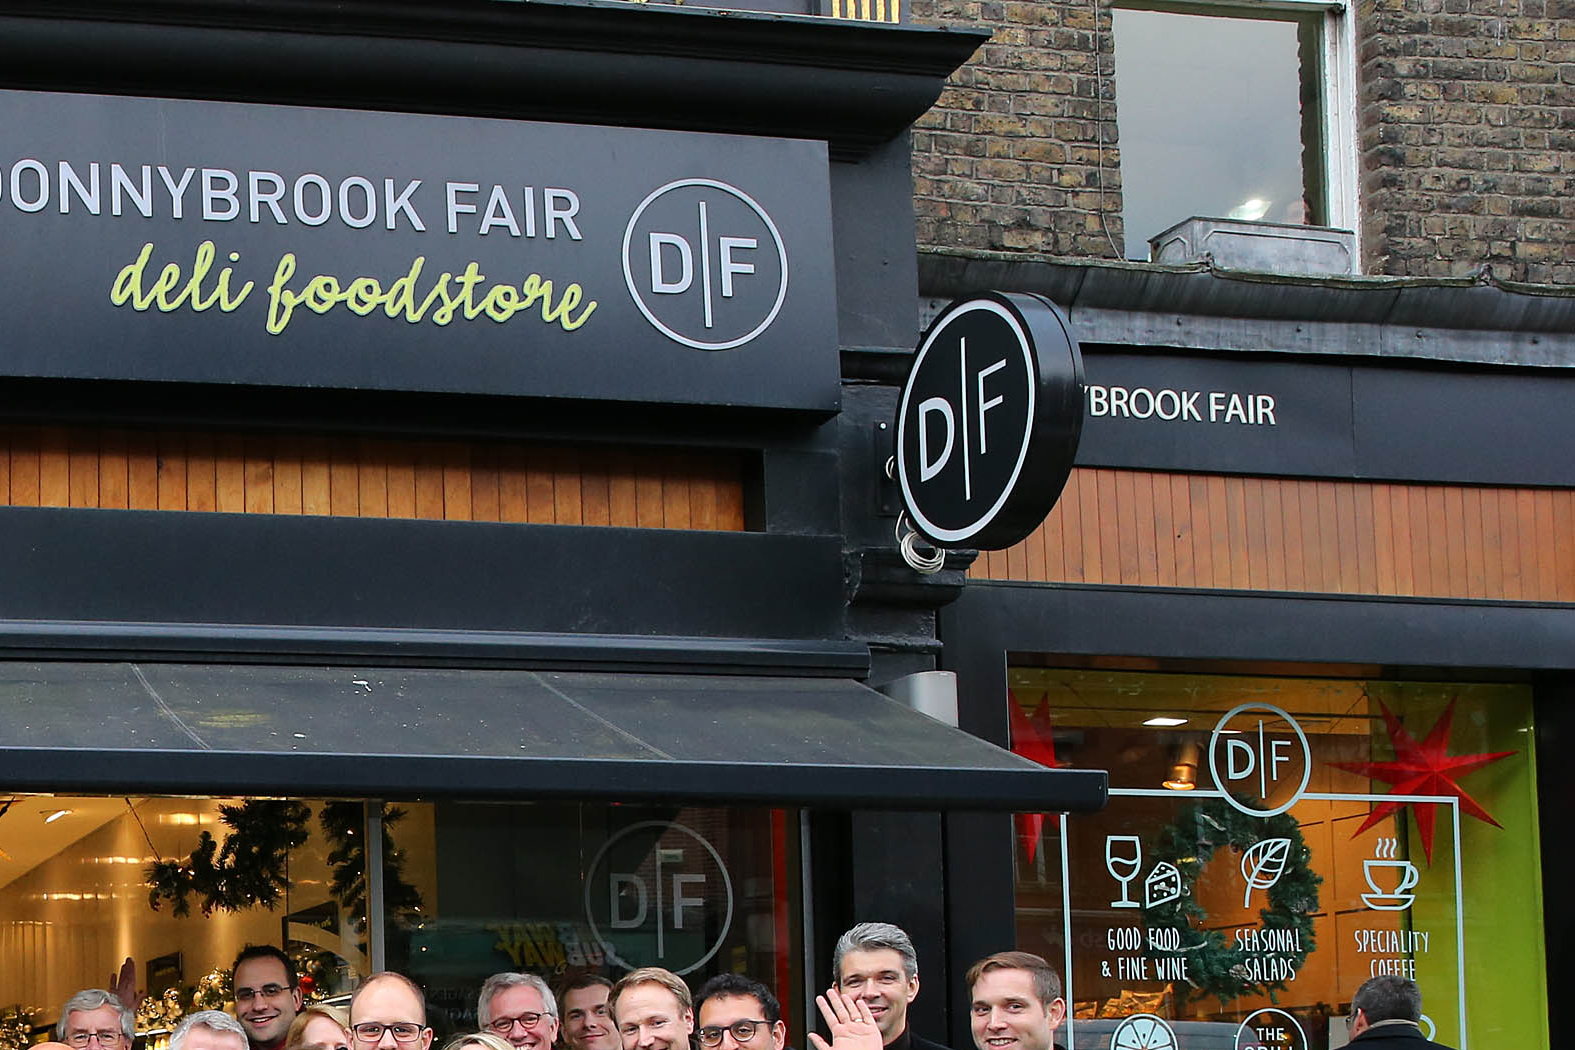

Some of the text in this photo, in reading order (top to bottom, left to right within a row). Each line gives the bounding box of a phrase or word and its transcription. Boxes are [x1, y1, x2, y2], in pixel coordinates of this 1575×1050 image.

[446, 181, 583, 240] FAIR
[111, 240, 598, 335] deli foodstore
[1083, 385, 1276, 425] BROOK FAIR
[1107, 927, 1181, 951] GOOD FOOD
[1235, 927, 1303, 953] SEASONAL
[1354, 929, 1430, 953] SPECIALITY
[1101, 956, 1189, 981] & FINE WINE
[1245, 957, 1296, 981] SALADS
[1256, 1027, 1285, 1041] THE
